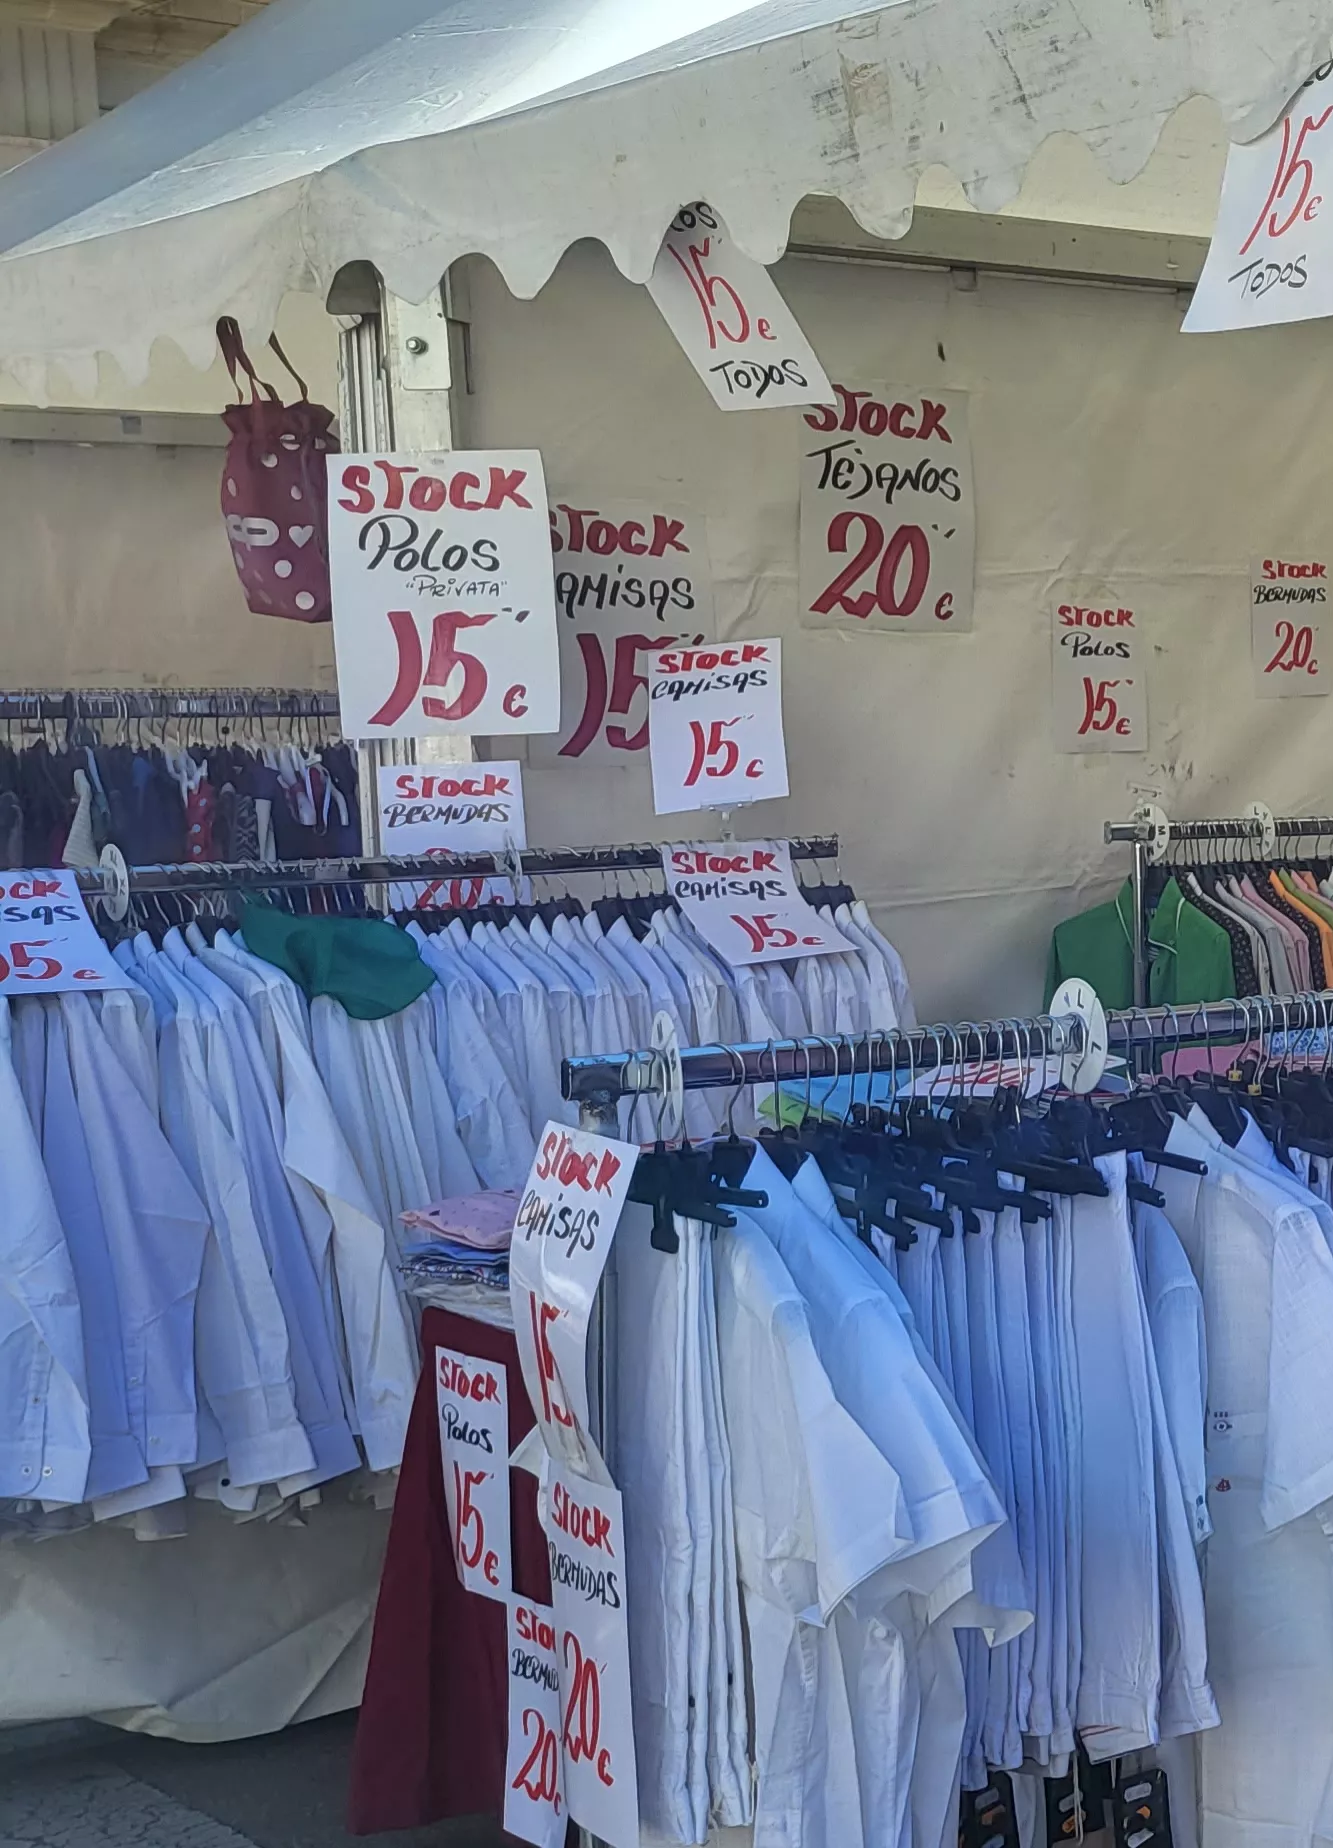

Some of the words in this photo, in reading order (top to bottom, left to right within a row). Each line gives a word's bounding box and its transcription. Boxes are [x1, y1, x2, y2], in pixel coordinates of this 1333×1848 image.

[1228, 254, 1308, 299] TODOS
[710, 358, 808, 398] TODOS
[803, 384, 952, 443] STOCK
[337, 460, 533, 514] STOCK
[805, 440, 962, 504] TEJANOS
[1262, 559, 1328, 579] STOCK
[556, 565, 695, 622] AMISAS
[1253, 584, 1327, 604] BERMUDAS
[1057, 605, 1136, 628] STOCK
[655, 644, 772, 674] STOCK
[651, 669, 768, 701] CAMISAS
[395, 773, 514, 799] STOCK
[383, 803, 512, 828] BERMUDAS
[671, 850, 783, 875] STOCK
[675, 876, 788, 900] CAMISAS
[535, 1130, 621, 1198] STOCK
[515, 1189, 600, 1259] CAMISAS
[438, 1355, 502, 1405] STOCK
[551, 1480, 615, 1558] STOCK
[548, 1541, 621, 1610] BERMUDAS
